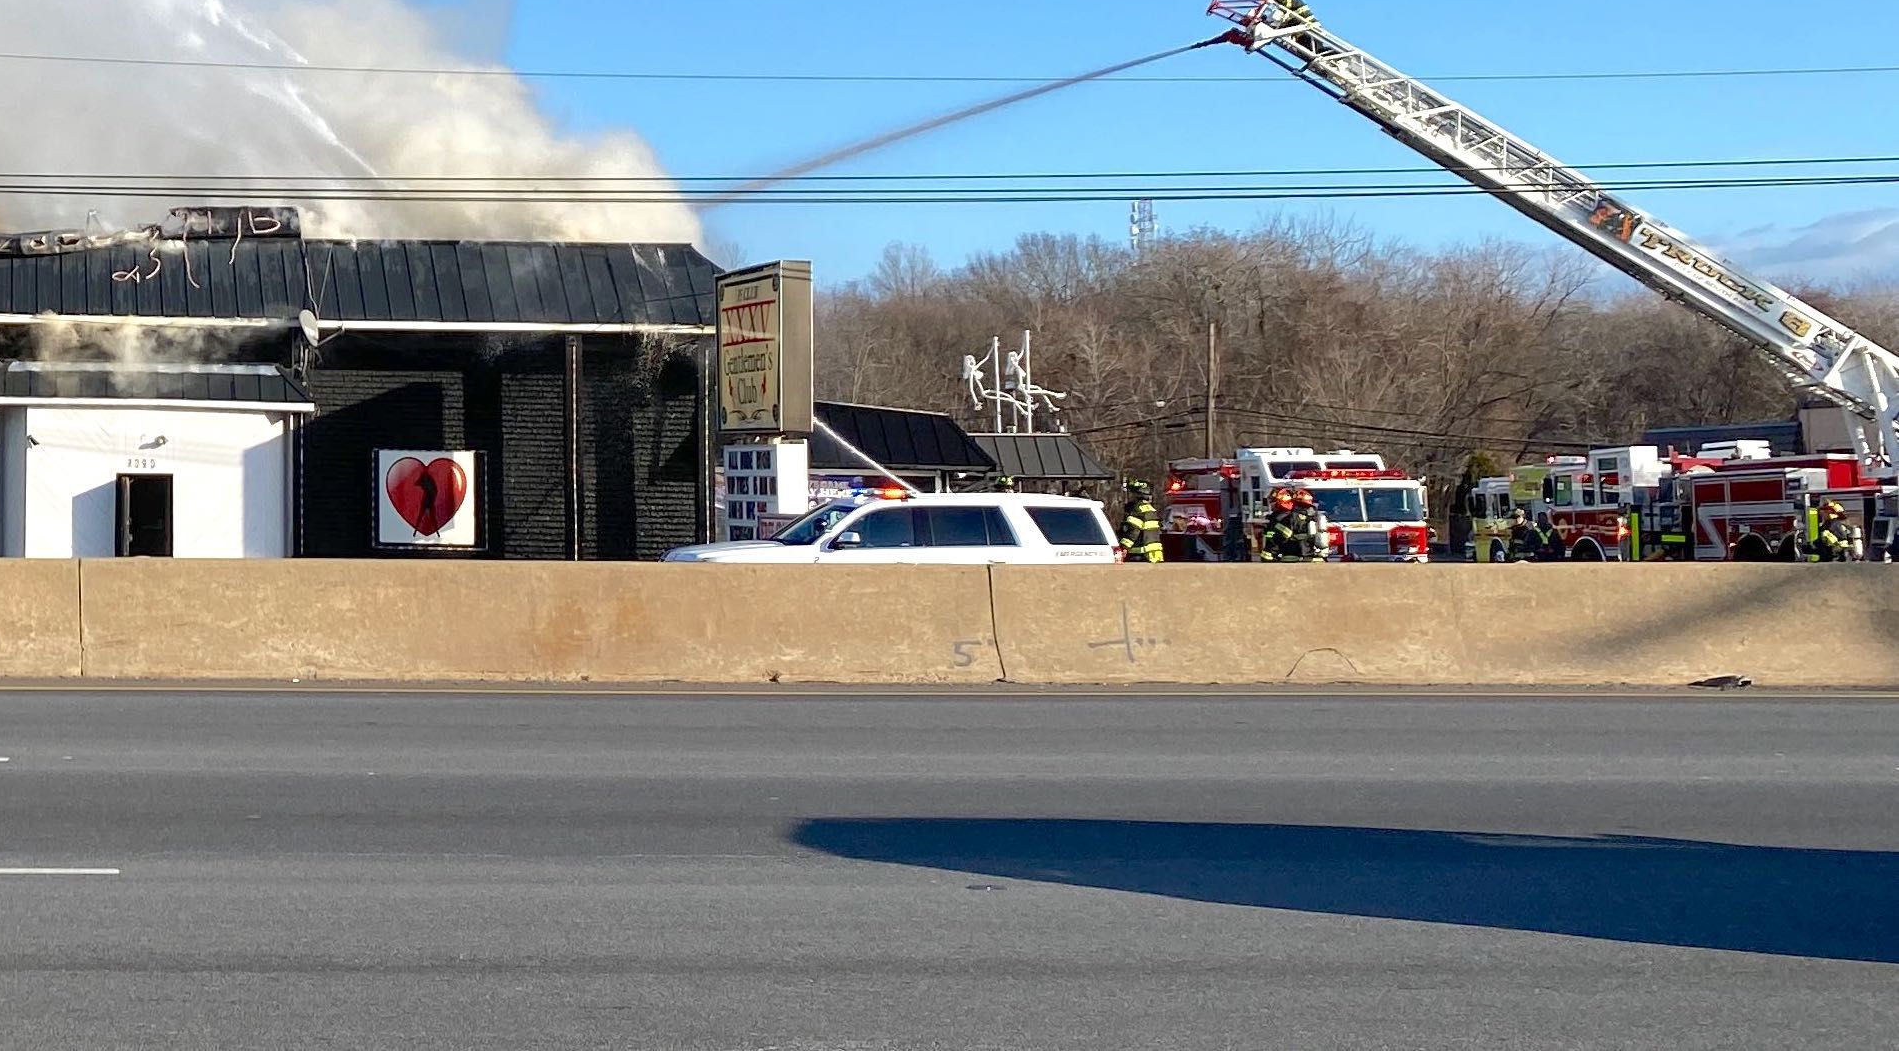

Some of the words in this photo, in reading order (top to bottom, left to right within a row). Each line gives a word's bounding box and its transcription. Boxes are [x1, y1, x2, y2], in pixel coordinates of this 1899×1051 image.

[1639, 228, 1774, 312] TRUCK
[722, 300, 776, 347] XXXV
[737, 378, 758, 405] Club
